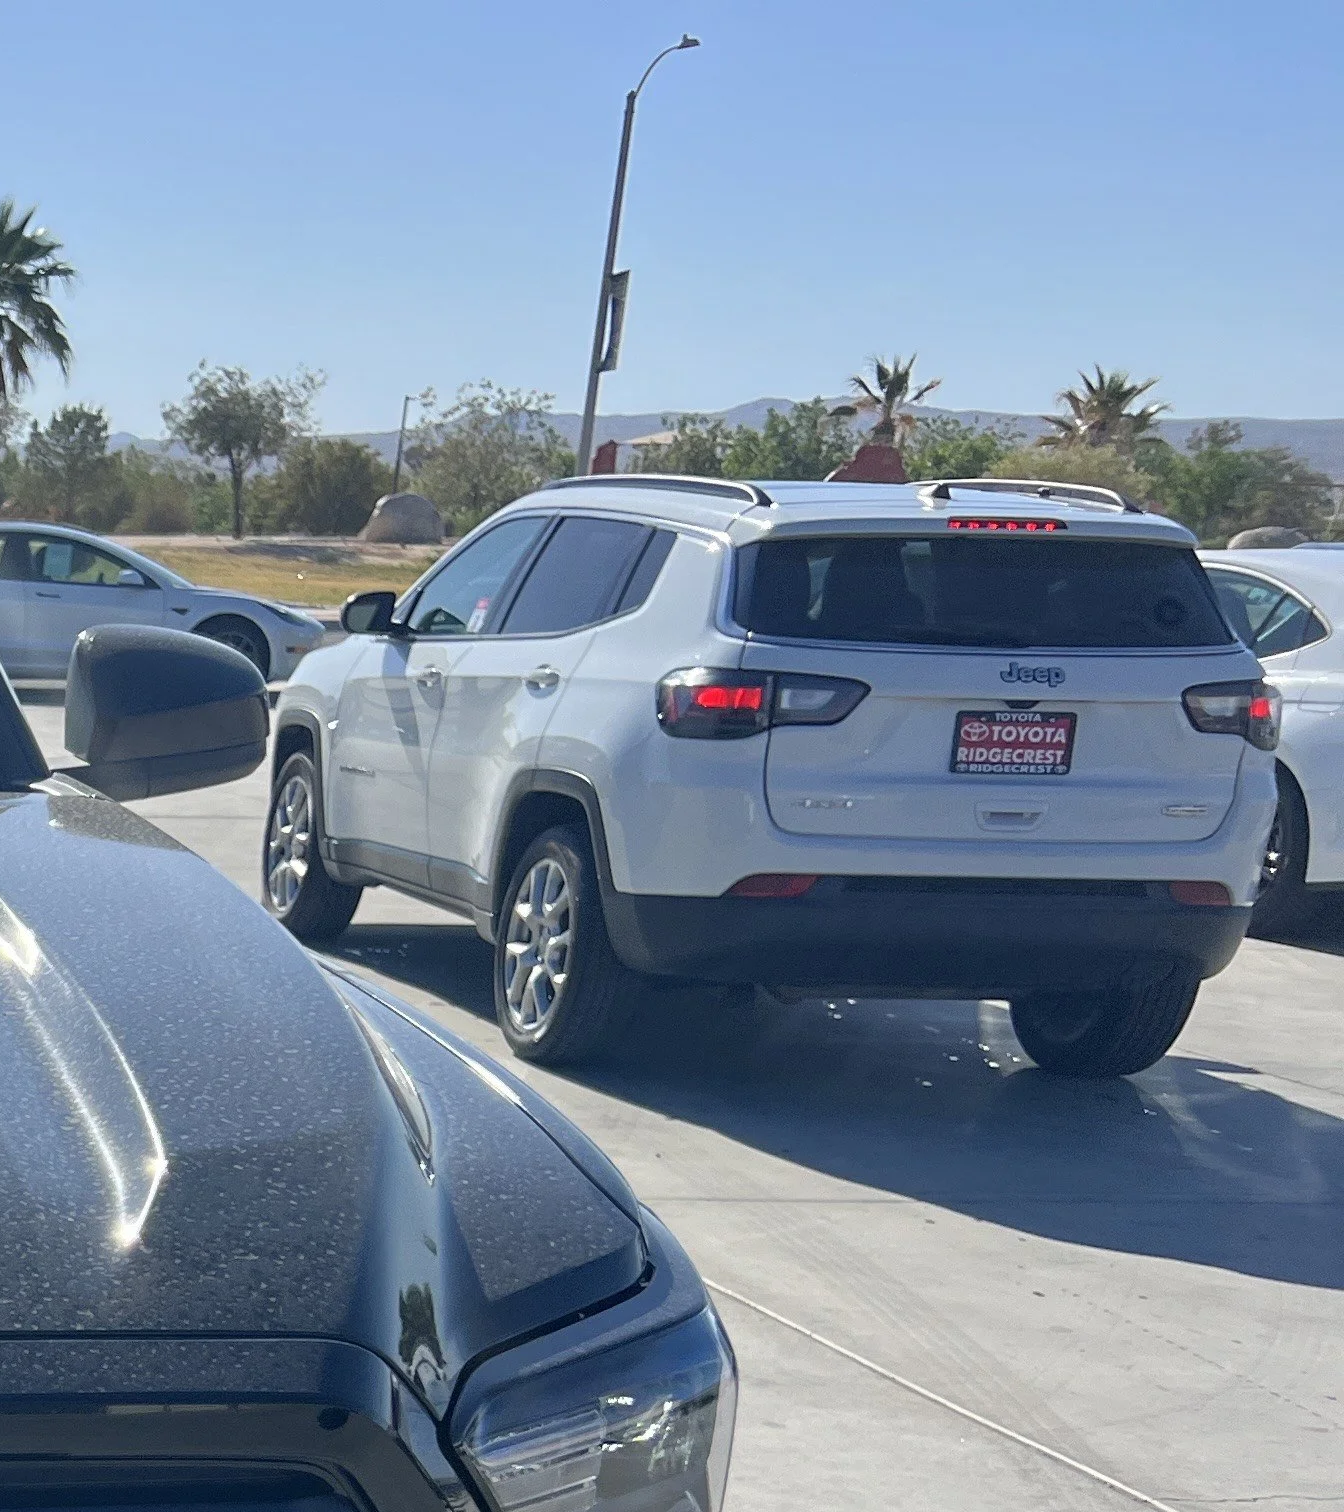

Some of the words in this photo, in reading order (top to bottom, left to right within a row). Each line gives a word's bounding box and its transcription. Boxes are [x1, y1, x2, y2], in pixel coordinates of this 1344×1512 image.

[1000, 661, 1065, 688] Jeep
[995, 712, 1041, 722] TOYOTA
[992, 725, 1066, 743] TOYOTA
[957, 748, 1064, 764] RIDGECREST
[969, 764, 1053, 774] RIDGECREST
